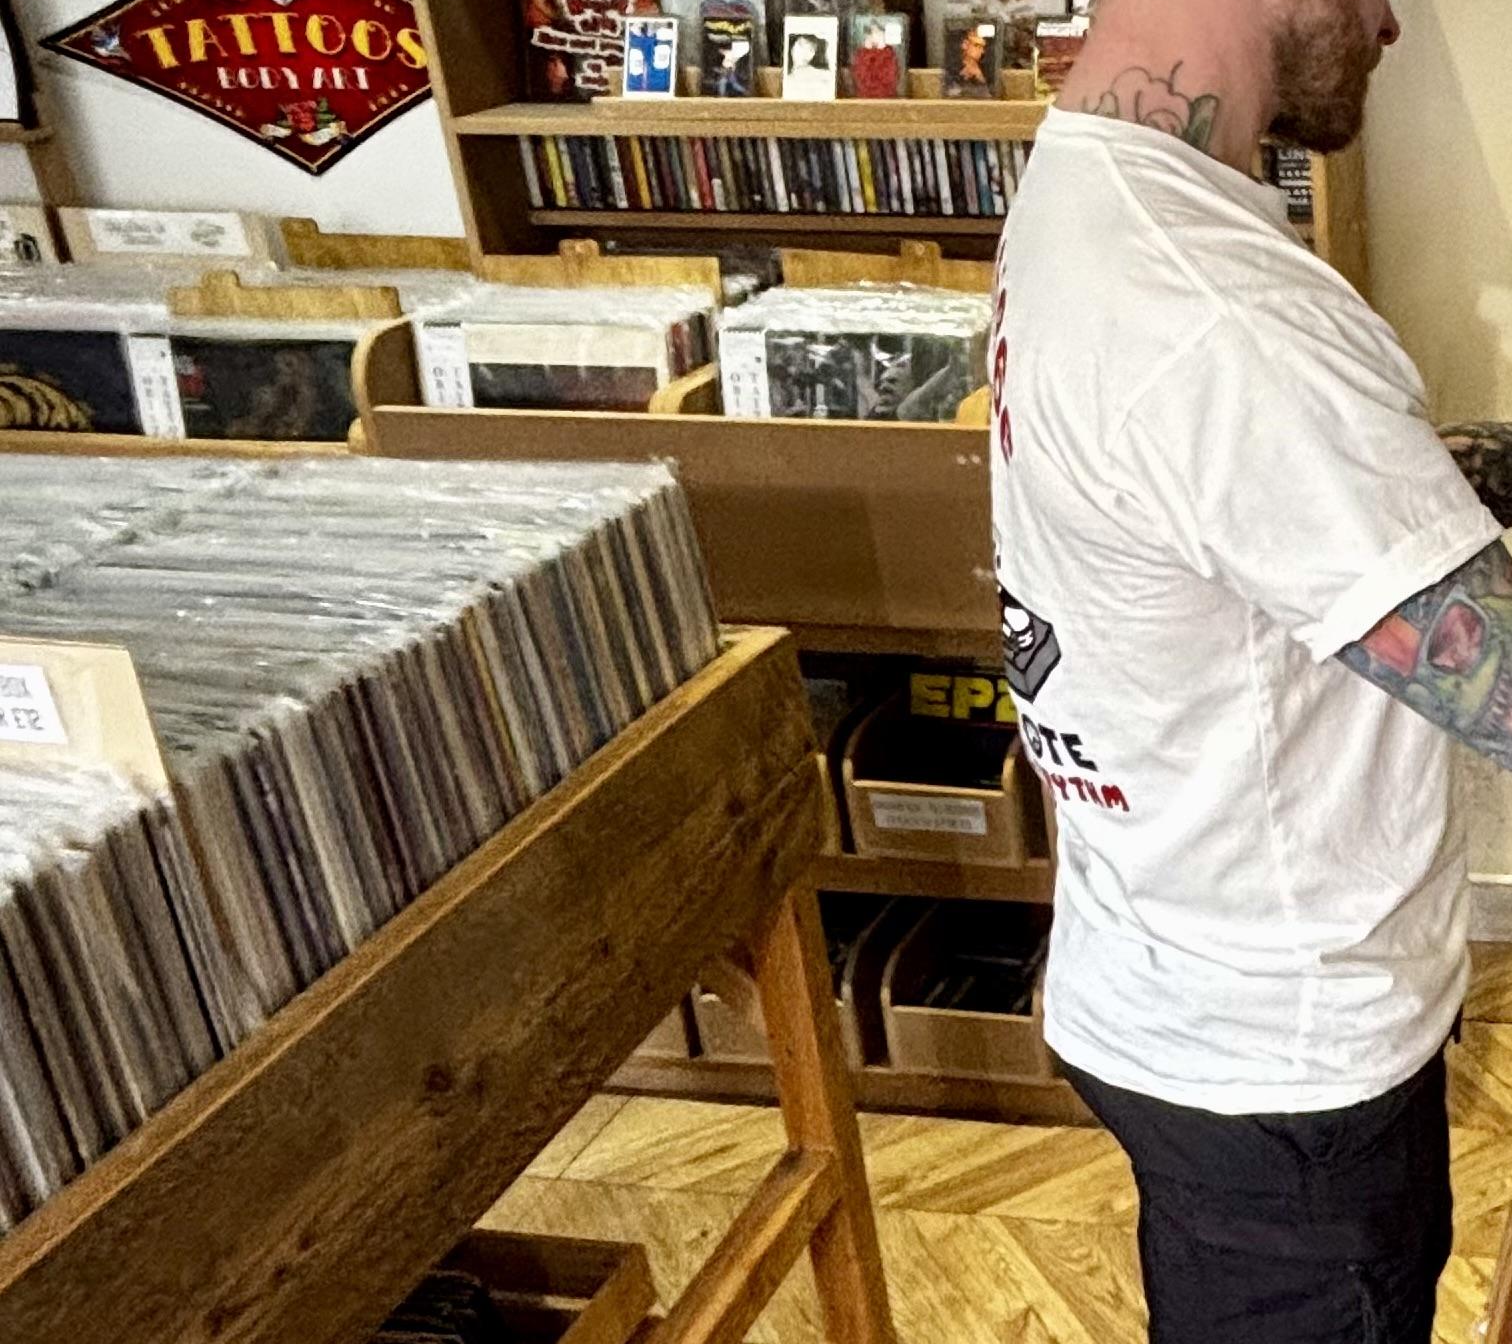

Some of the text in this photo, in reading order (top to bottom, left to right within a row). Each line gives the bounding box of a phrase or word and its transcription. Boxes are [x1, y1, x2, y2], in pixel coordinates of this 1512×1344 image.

[132, 12, 428, 69] TATTOOS
[217, 66, 370, 90] BODY ART
[1021, 713, 1100, 773] OTE
[1050, 772, 1130, 813] YTHM
